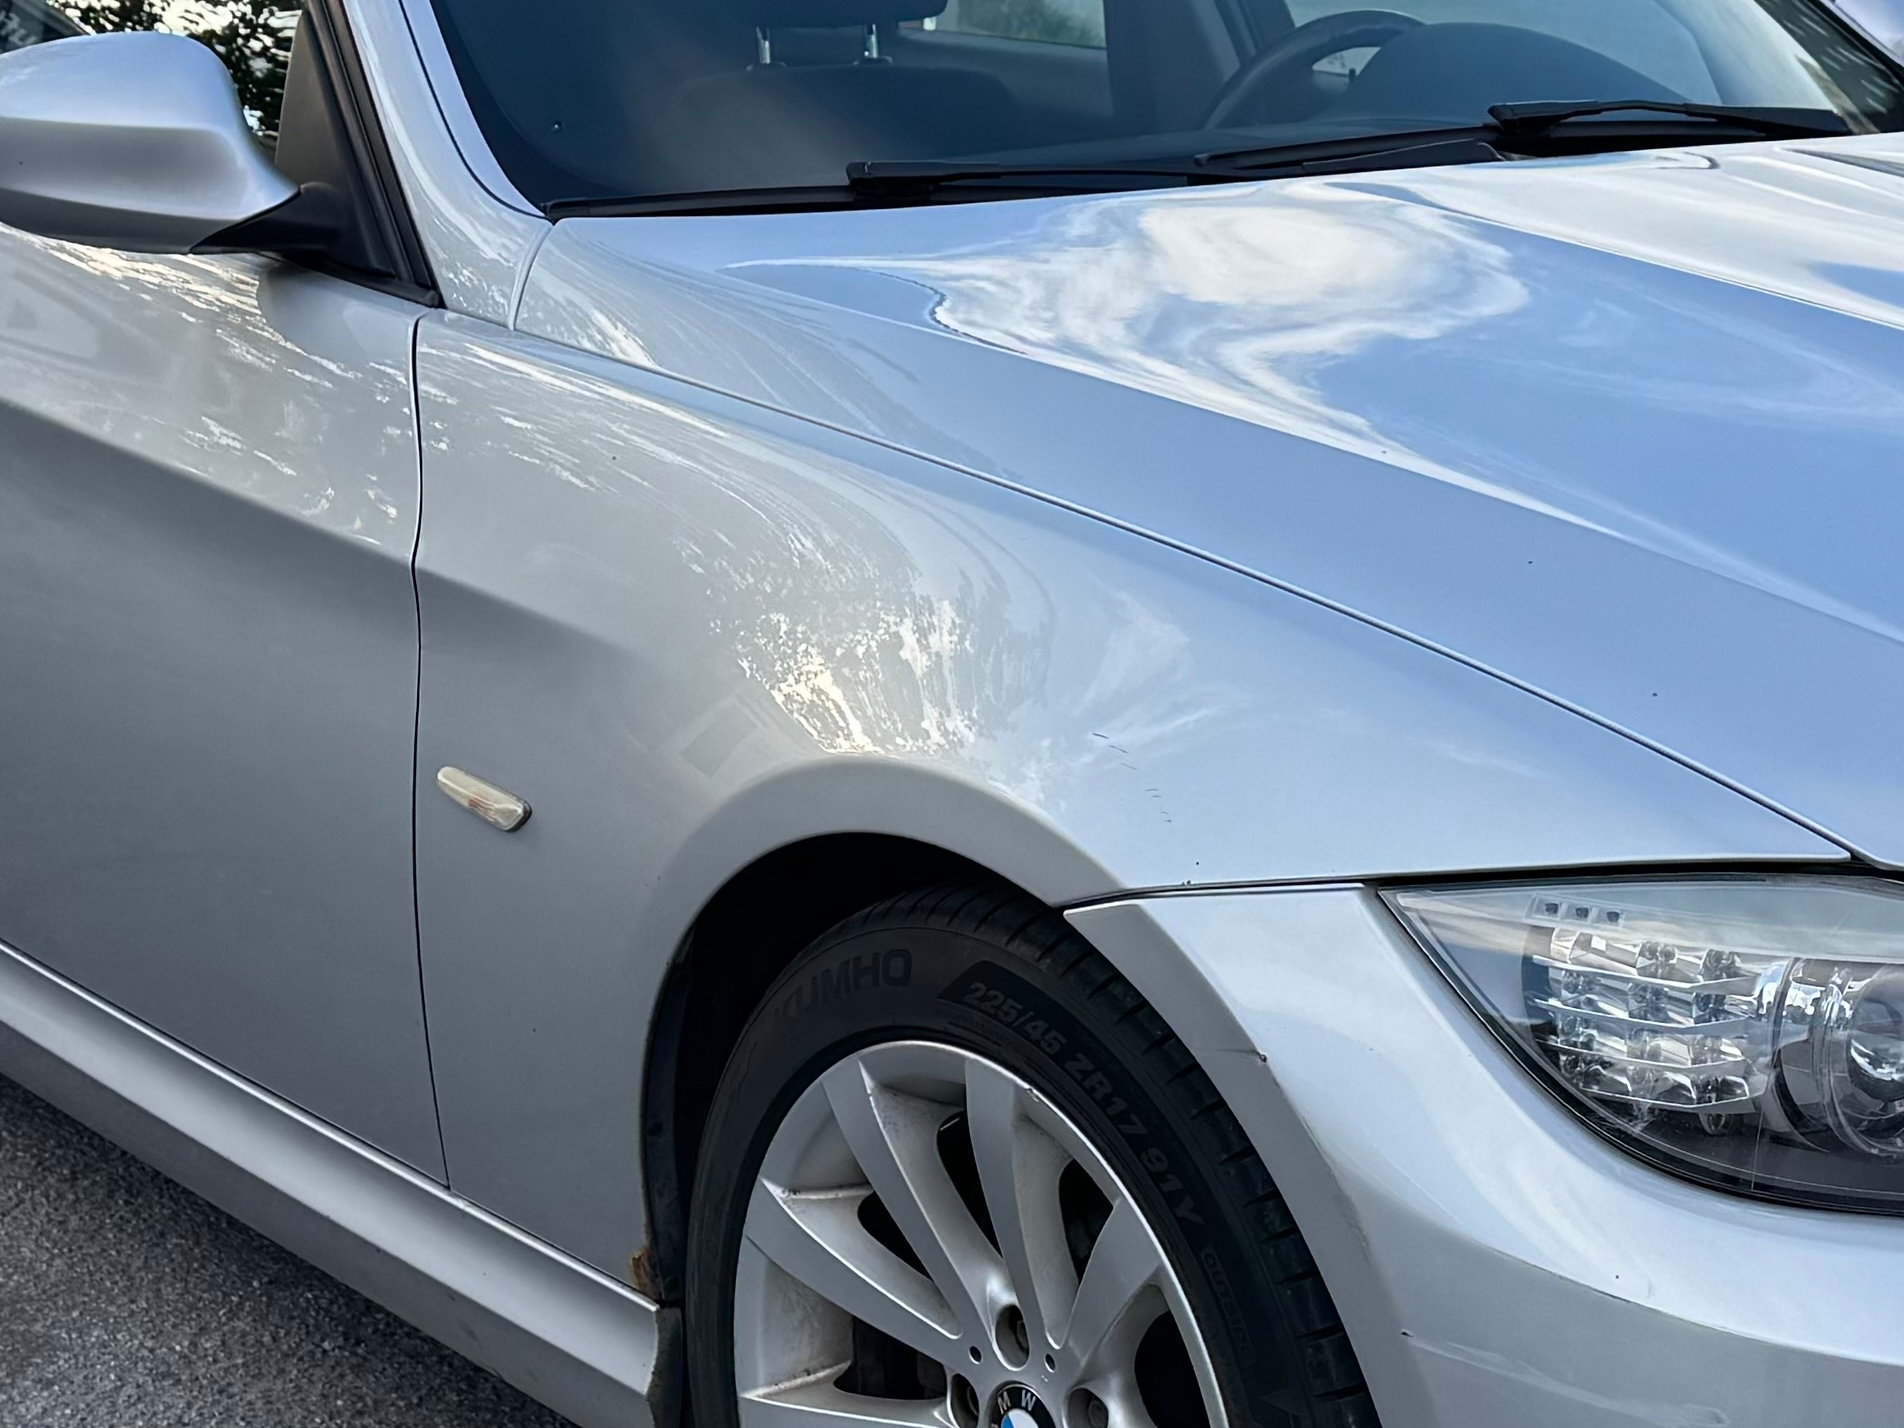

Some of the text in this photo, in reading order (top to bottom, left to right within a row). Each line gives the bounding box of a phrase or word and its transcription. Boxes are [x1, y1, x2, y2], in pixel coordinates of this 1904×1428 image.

[963, 981, 1205, 1225] 225/45 ZR17 91Y
